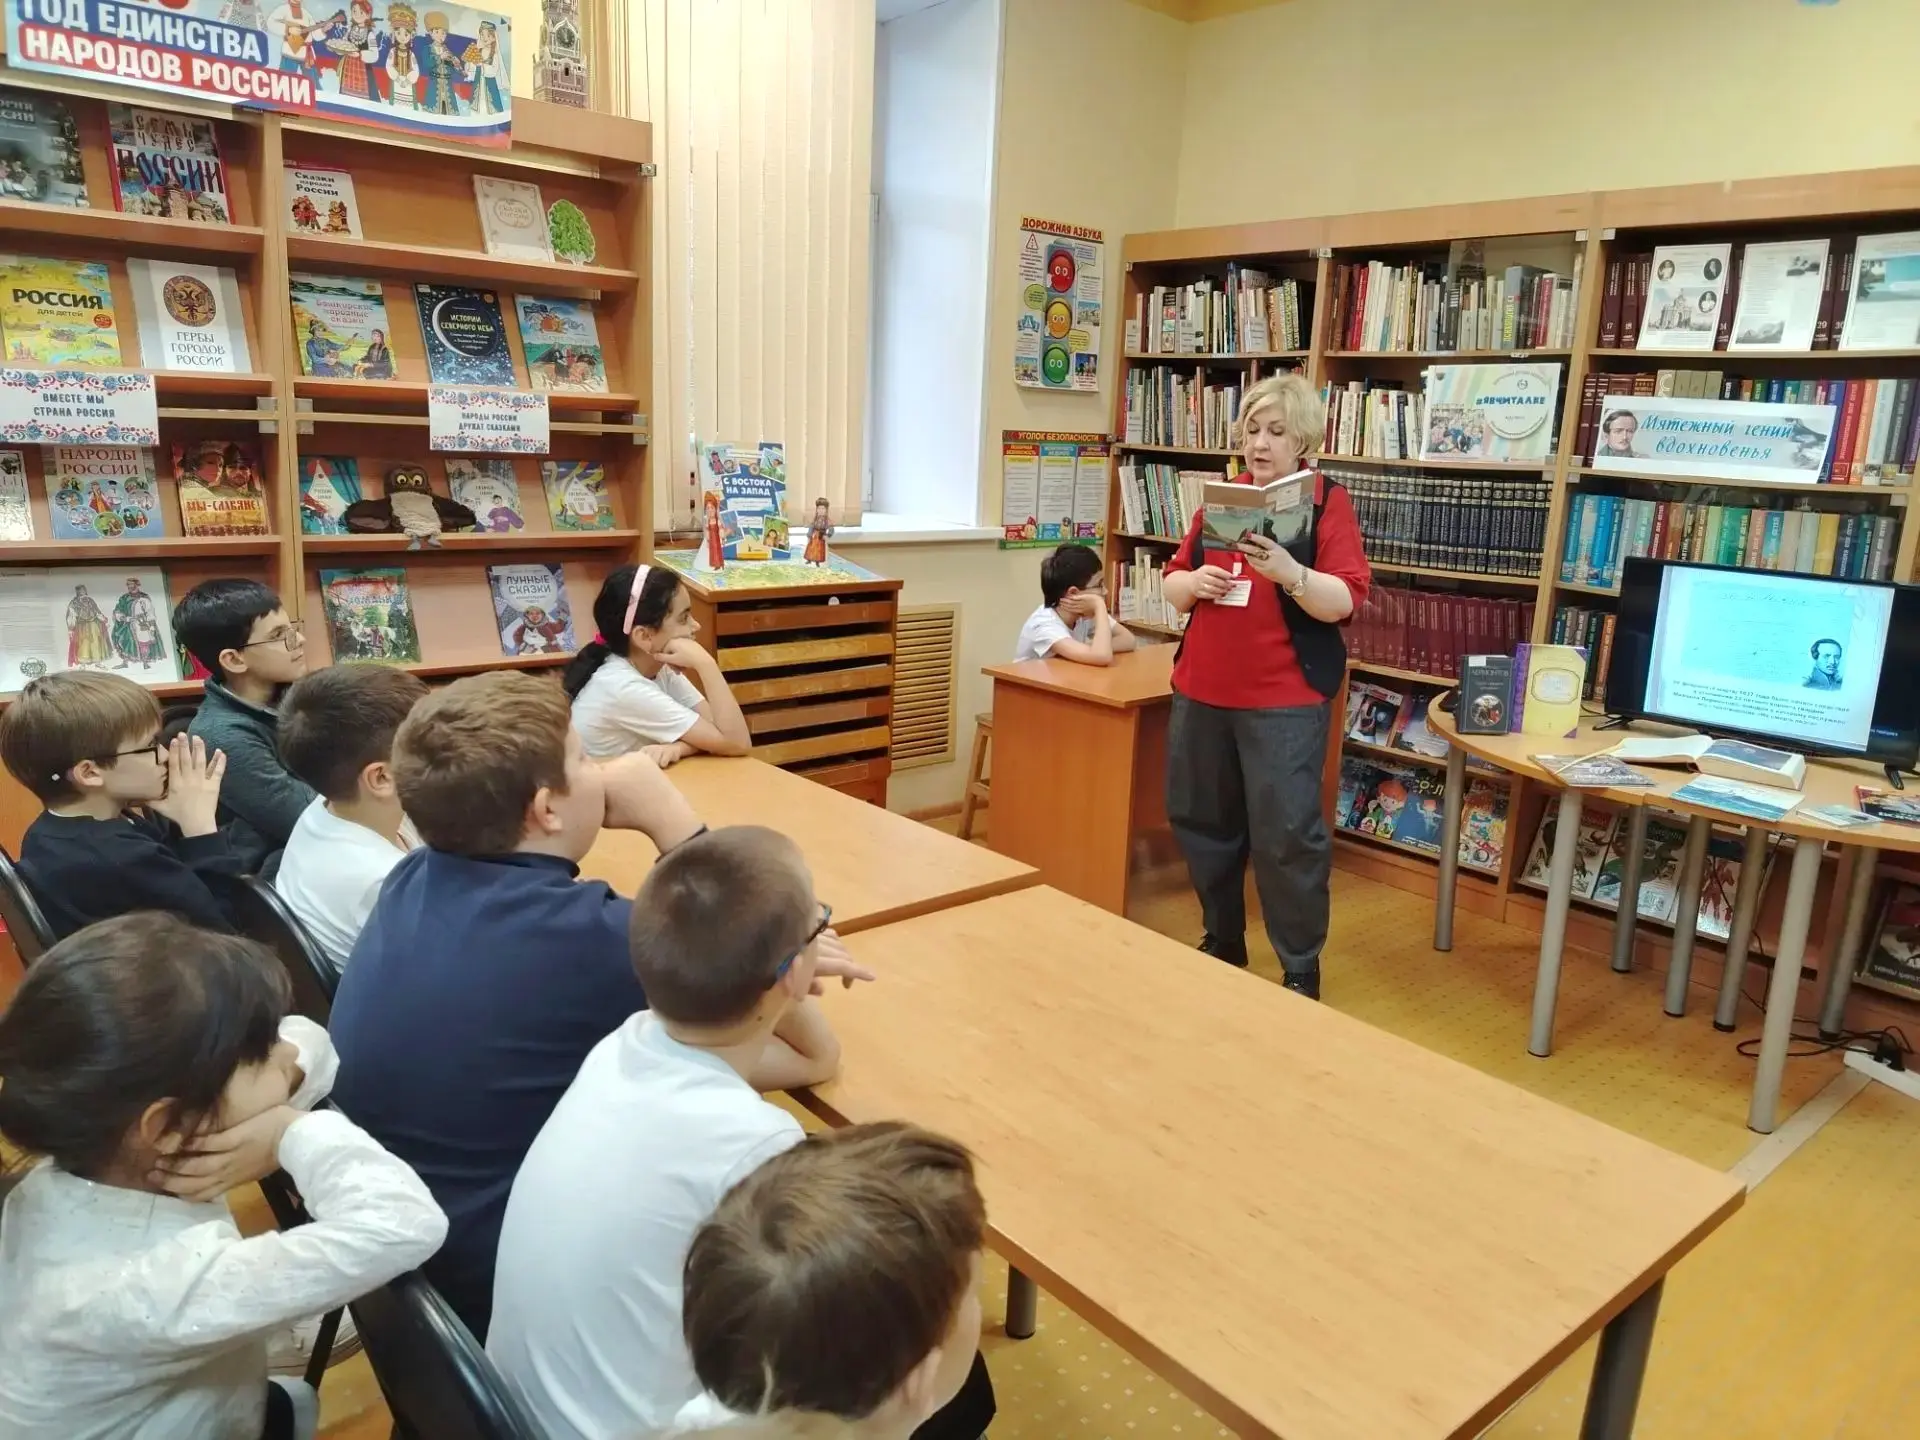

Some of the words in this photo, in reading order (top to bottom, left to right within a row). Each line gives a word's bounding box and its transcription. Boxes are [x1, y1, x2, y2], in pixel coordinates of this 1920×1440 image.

[22, 0, 89, 32] ГОД
[98, 3, 263, 62] ЕДИНСТВА
[24, 28, 184, 82] НАРОДОВ
[191, 58, 312, 106] РОССИИ
[116, 148, 225, 194] РОССИИ
[295, 172, 335, 183] Сказки
[296, 184, 339, 196] России
[1022, 217, 1071, 234] ДОРОЖНАЯ
[1073, 226, 1102, 240] АЗБУКА
[12, 288, 104, 310] РОССИЯ
[37, 308, 55, 316] для
[450, 314, 482, 323] ИСТОРИИ
[176, 331, 215, 343] ГЕРБЫ
[171, 343, 226, 355] ГОРОДОВ
[176, 355, 224, 366] РОССИИ
[43, 393, 83, 403] ВМЕСТЕ
[86, 394, 105, 404] МЫ
[1476, 396, 1546, 406] #ЯВЧИТАЛКЕ
[33, 406, 72, 417] СТРАНА
[76, 408, 116, 418] РОССИЯ
[461, 412, 490, 421] НАРОДЫ
[459, 422, 484, 430] ДРУЖАТ
[486, 423, 521, 432] СКАЗКАМИ
[1640, 415, 1734, 435] Мятежный
[1018, 431, 1045, 440] УГОЛОК
[1046, 433, 1099, 441] БЕЗОПАСНОСТИ
[1655, 436, 1772, 460] вдохновенья
[60, 448, 137, 462] НАРОДЫ
[63, 464, 139, 475] РОССИИ
[732, 478, 772, 486] ВОСТОКА
[726, 486, 739, 494] НА
[741, 487, 771, 496] ЗАПАД
[506, 574, 551, 585] ЛУННЫЕ
[508, 584, 551, 594] СКАЗКИ
